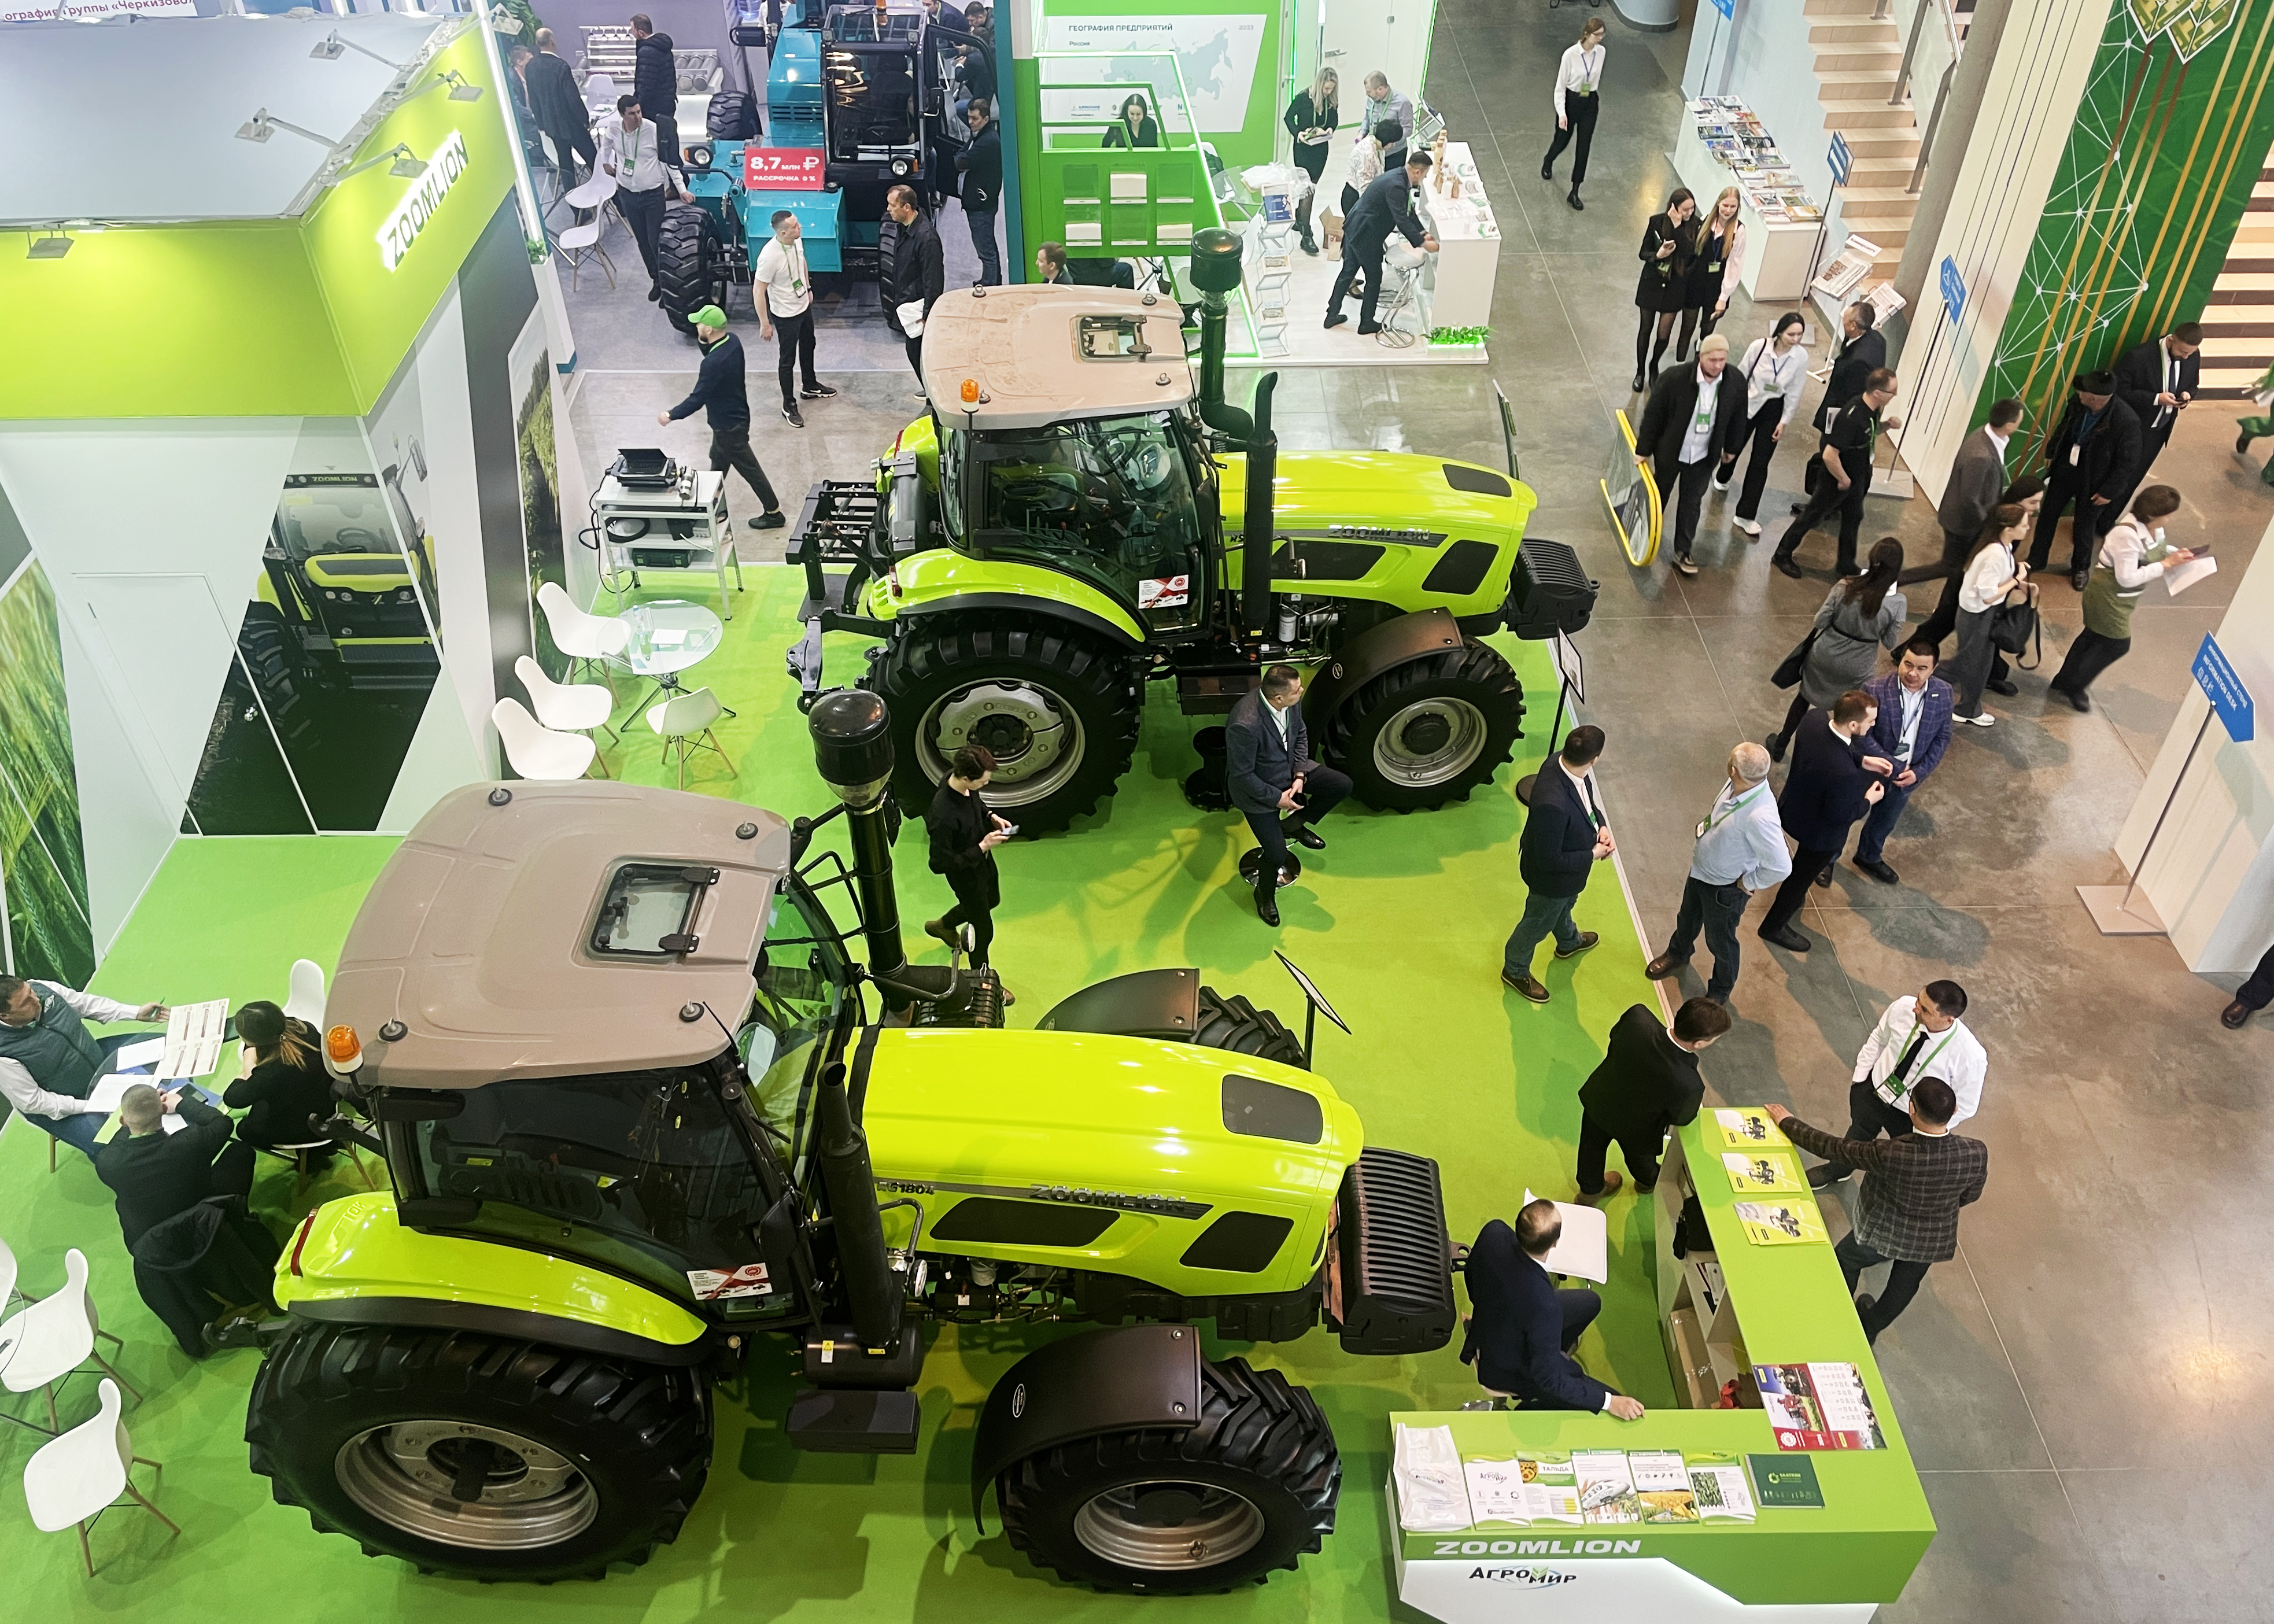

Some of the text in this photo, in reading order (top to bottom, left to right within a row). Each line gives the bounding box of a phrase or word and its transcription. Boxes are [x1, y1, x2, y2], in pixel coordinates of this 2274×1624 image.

[3, 8, 58, 21] ография
[1116, 23, 1173, 31] ПРЕДПРИЯТИЙ
[750, 156, 781, 171] 8,7
[387, 134, 469, 268] ZOOMLION
[1327, 524, 1430, 541] ZOOMLION
[2203, 654, 2238, 711] INFORMATION DESK
[1029, 1183, 1186, 1211] ZOOMLION
[1433, 1540, 1641, 1555] ZOOMLION
